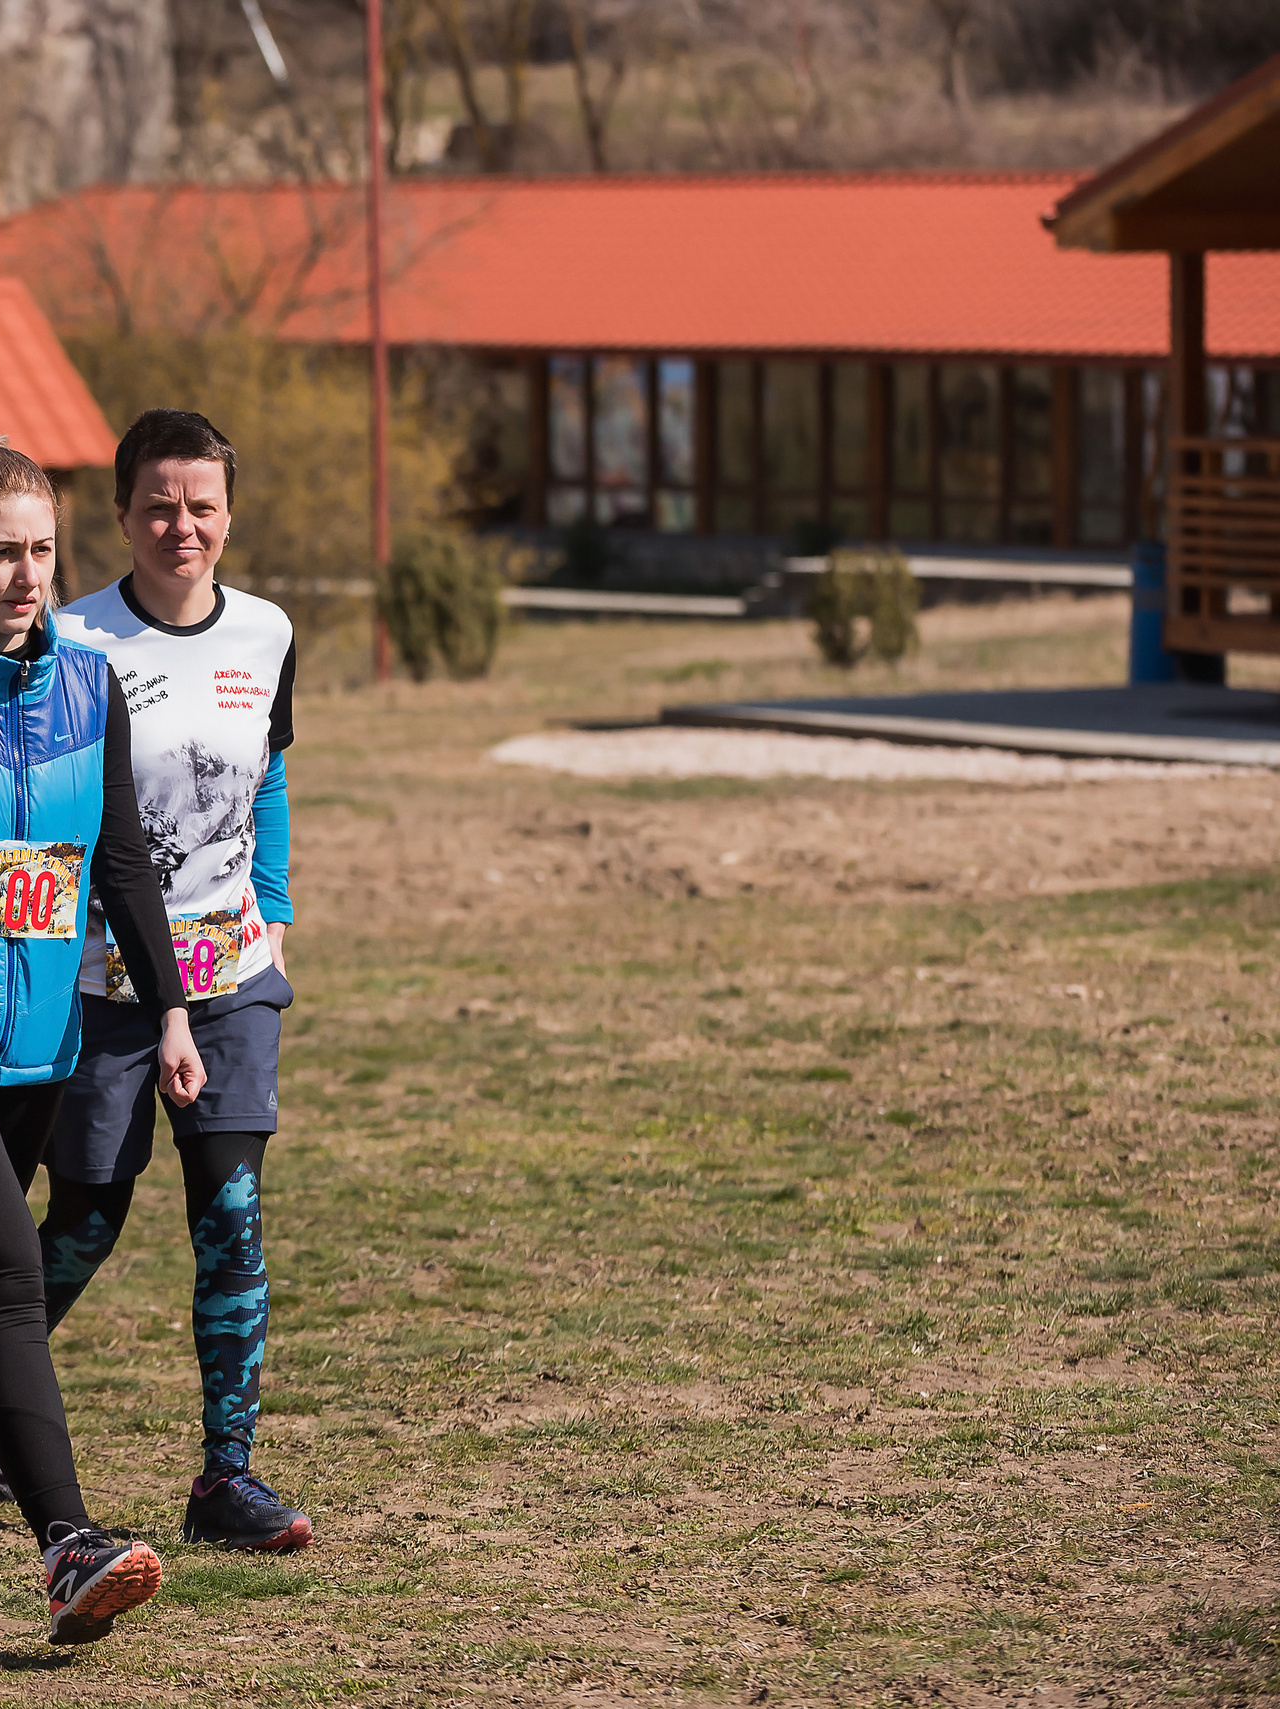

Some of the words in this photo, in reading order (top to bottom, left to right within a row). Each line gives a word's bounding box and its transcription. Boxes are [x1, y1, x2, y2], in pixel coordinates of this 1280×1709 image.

[118, 670, 138, 685] РИЯ
[129, 690, 169, 715] АФОНОВ
[47, 855, 72, 885] TRAIL
[203, 923, 233, 949] TRAIL
